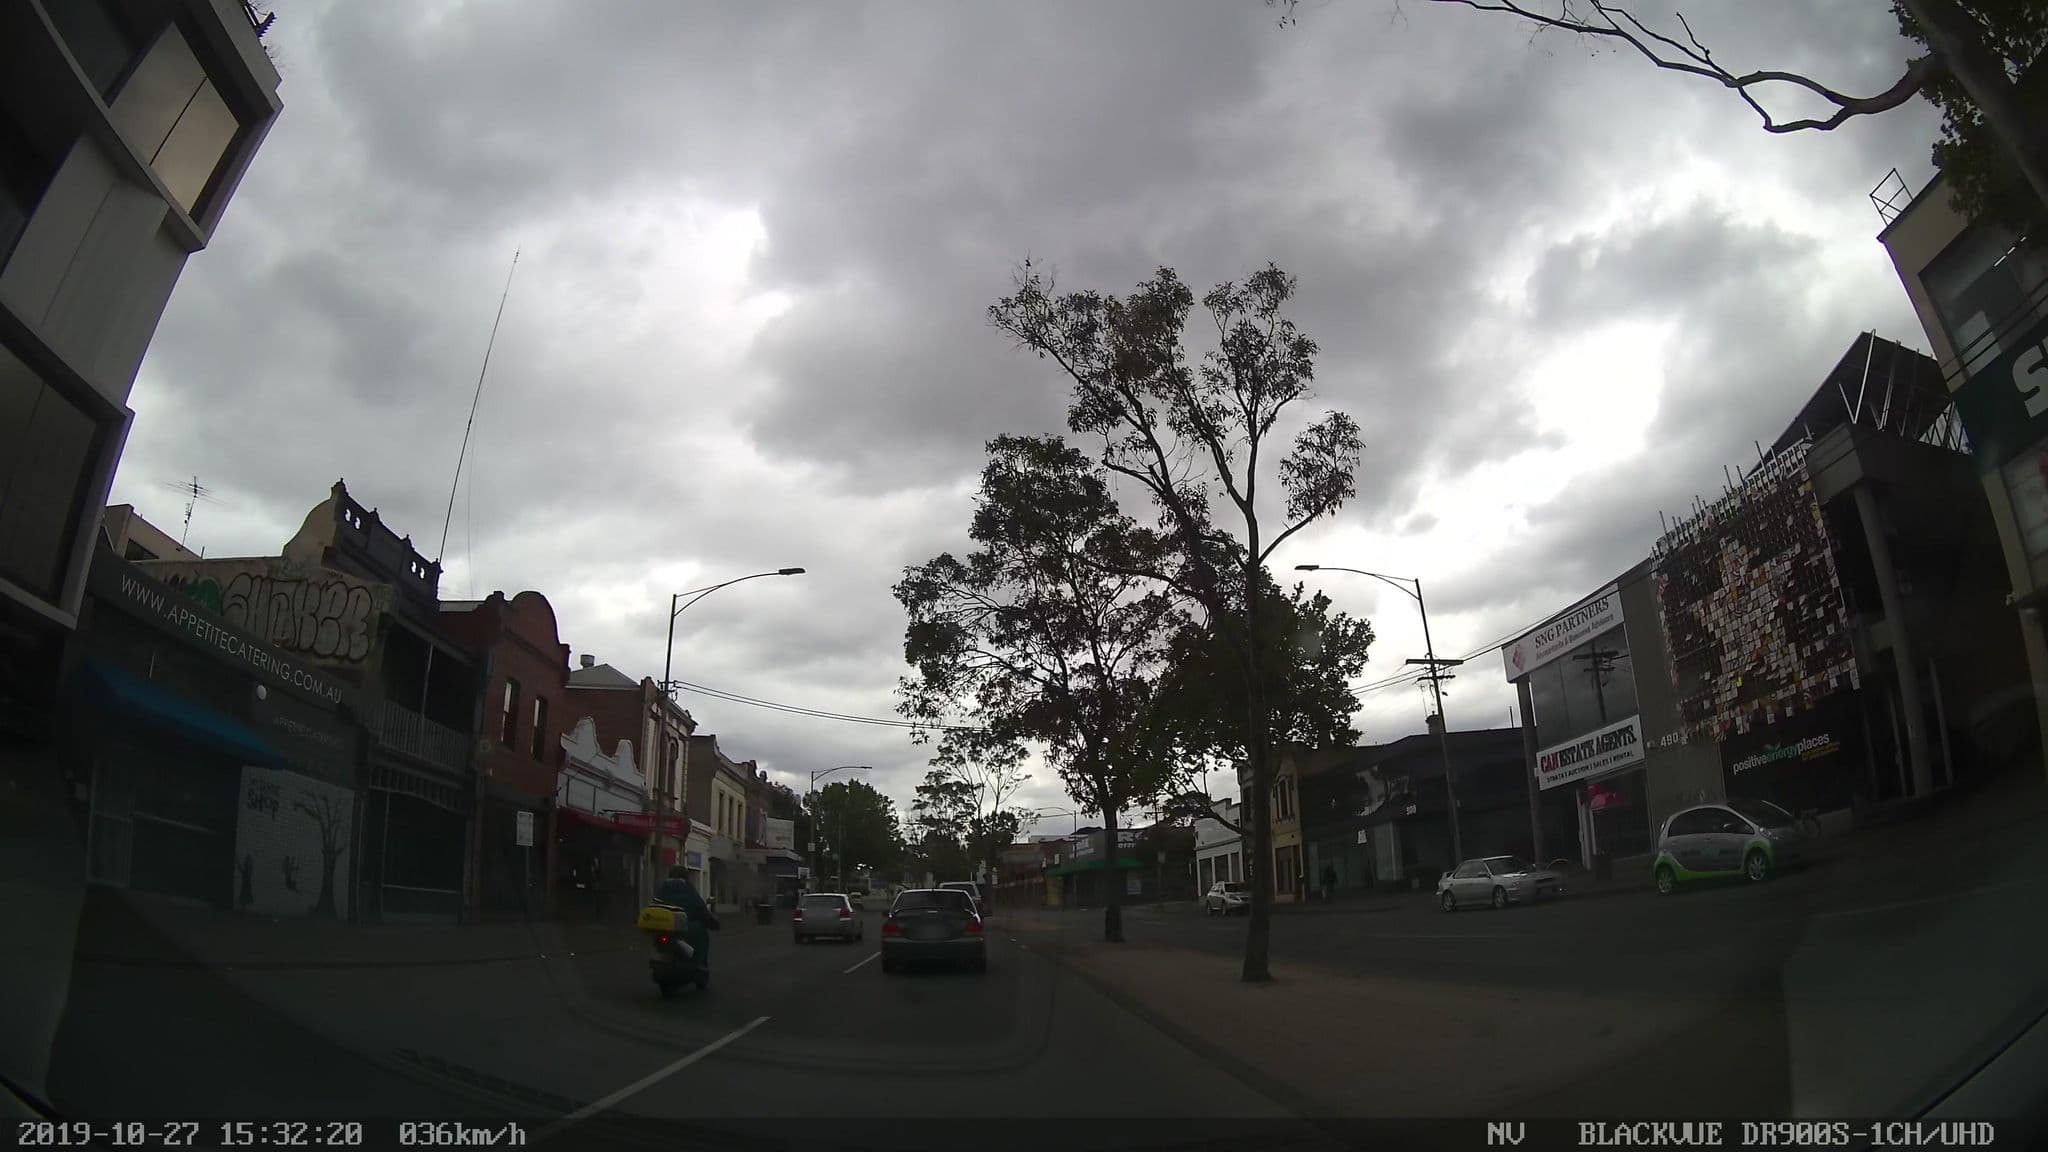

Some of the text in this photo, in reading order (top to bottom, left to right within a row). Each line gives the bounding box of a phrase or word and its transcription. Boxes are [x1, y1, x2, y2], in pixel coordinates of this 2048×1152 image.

[121, 574, 342, 703] WWW.APPETITECATERING.COM.AU
[1534, 597, 1610, 648] SNG PARTNERS
[1559, 738, 1595, 768] ESTATE
